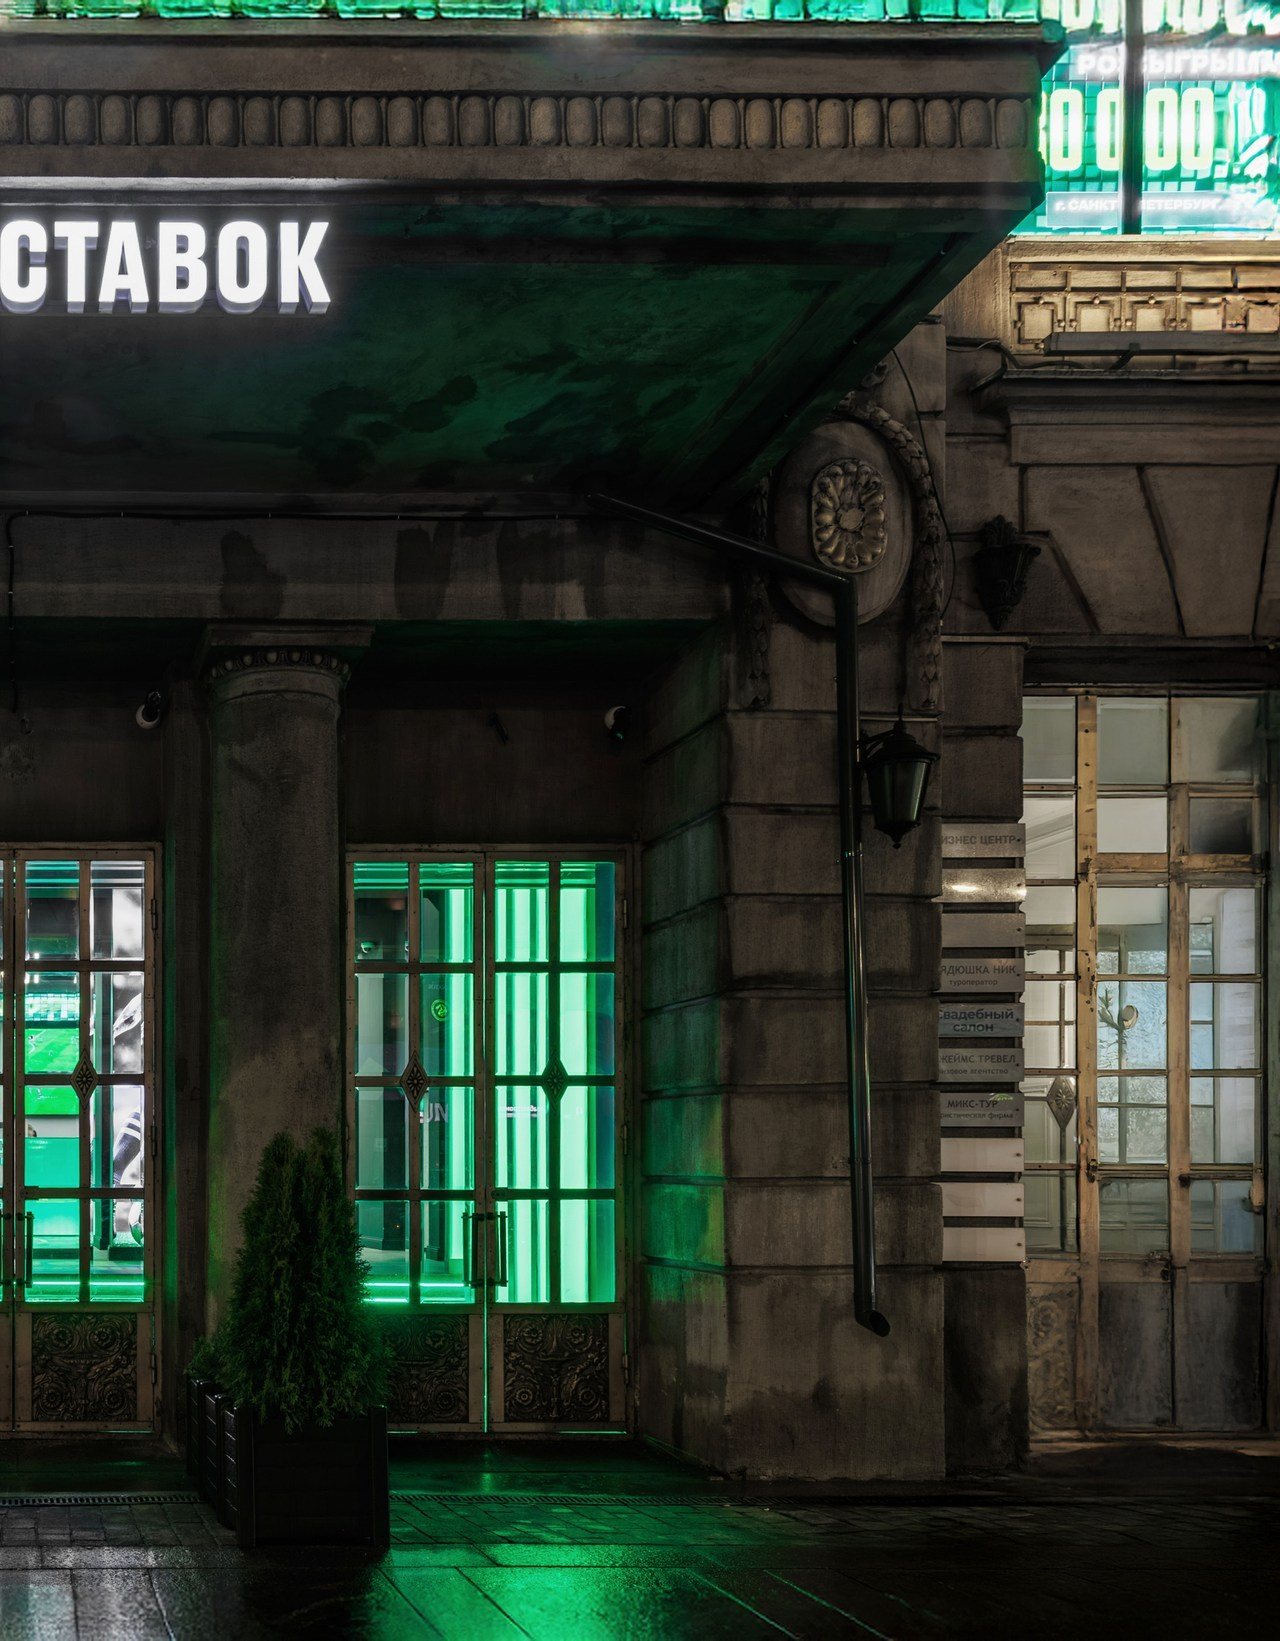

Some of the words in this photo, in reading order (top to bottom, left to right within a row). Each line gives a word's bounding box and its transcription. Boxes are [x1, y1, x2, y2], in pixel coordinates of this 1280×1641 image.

[941, 835, 977, 845] ИЗНЕС
[980, 835, 1016, 846] ЦЕНТР
[940, 965, 990, 976] ЯДЮШКА
[993, 965, 1016, 975] НИК
[952, 1023, 994, 1032] салон
[939, 1053, 975, 1063] ЖЕЙМС
[977, 1054, 1016, 1063] ТРЕВЕЛ
[947, 1100, 998, 1108] МИКС-ТУР
